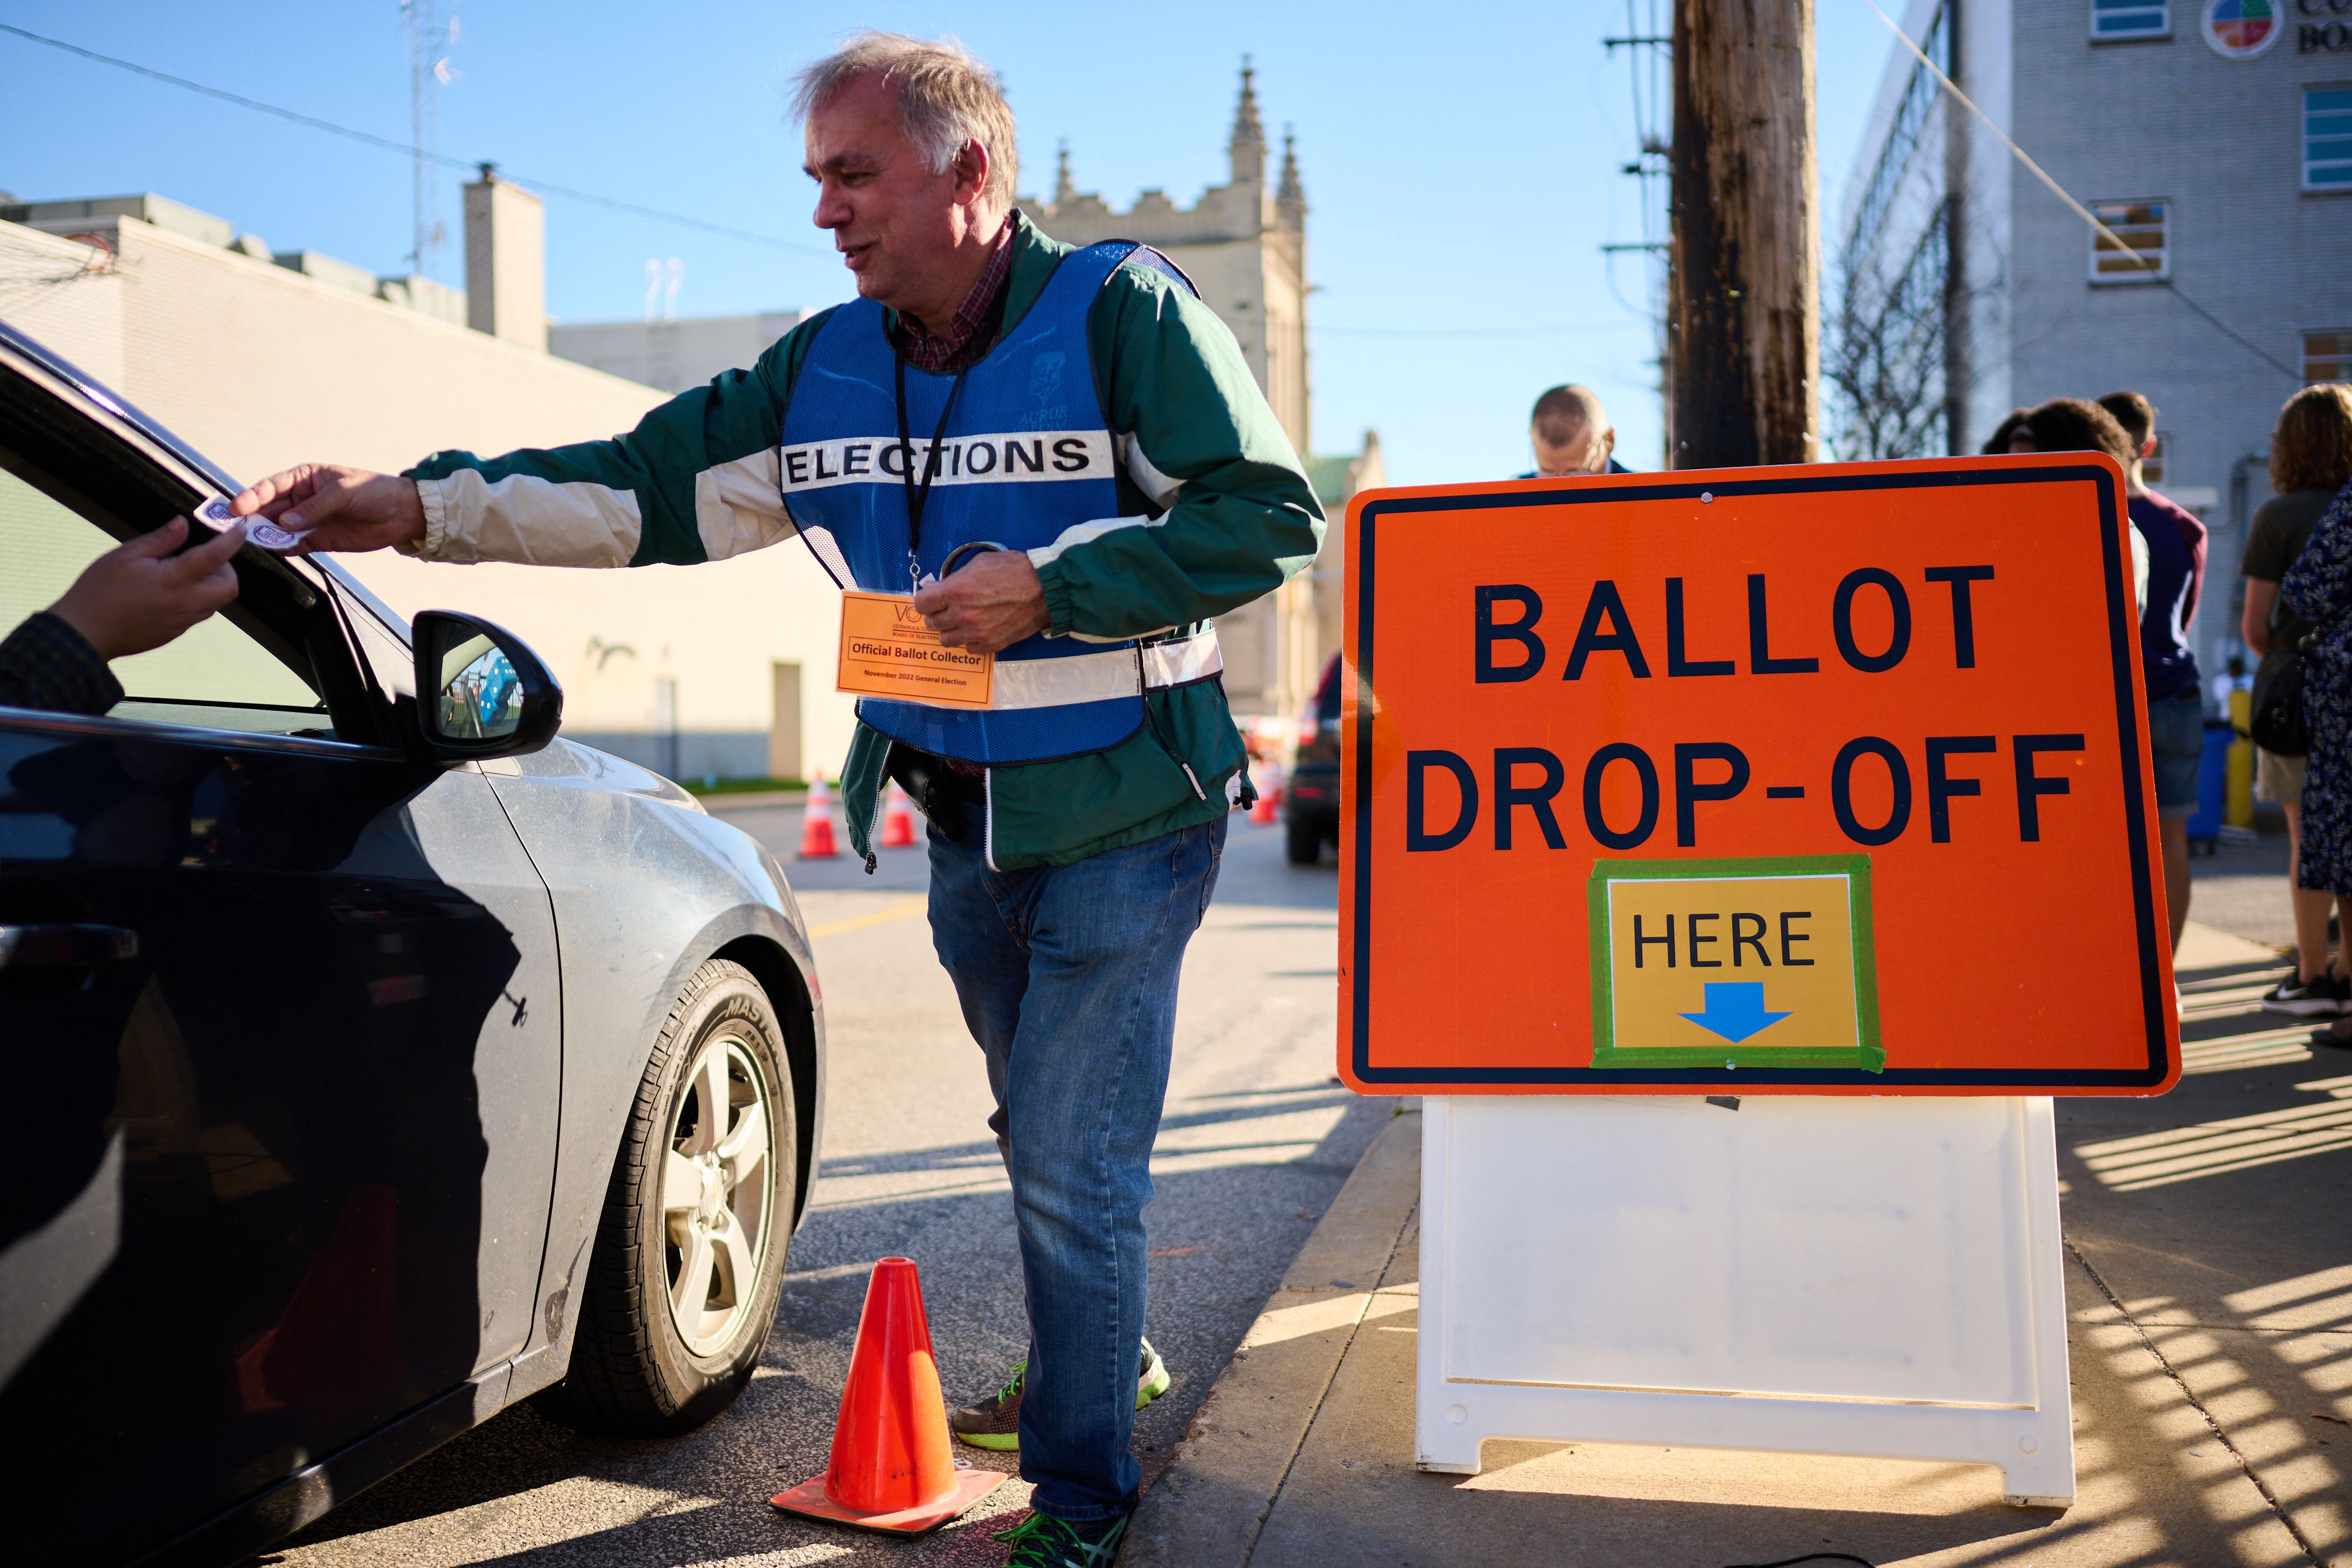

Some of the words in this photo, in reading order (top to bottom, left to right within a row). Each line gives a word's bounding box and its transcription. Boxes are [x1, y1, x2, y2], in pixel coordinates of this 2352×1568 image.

[2298, 22, 2352, 54] BO
[785, 438, 1090, 484] ELECTIONS
[1475, 564, 1995, 684] BALLOT
[852, 643, 891, 656] Official
[894, 647, 927, 660] Ballot
[931, 651, 981, 665] Collector
[864, 669, 897, 678] November
[941, 677, 966, 686] Election
[1406, 733, 2086, 852] DROP-OFF
[1633, 911, 1815, 968] HERE
